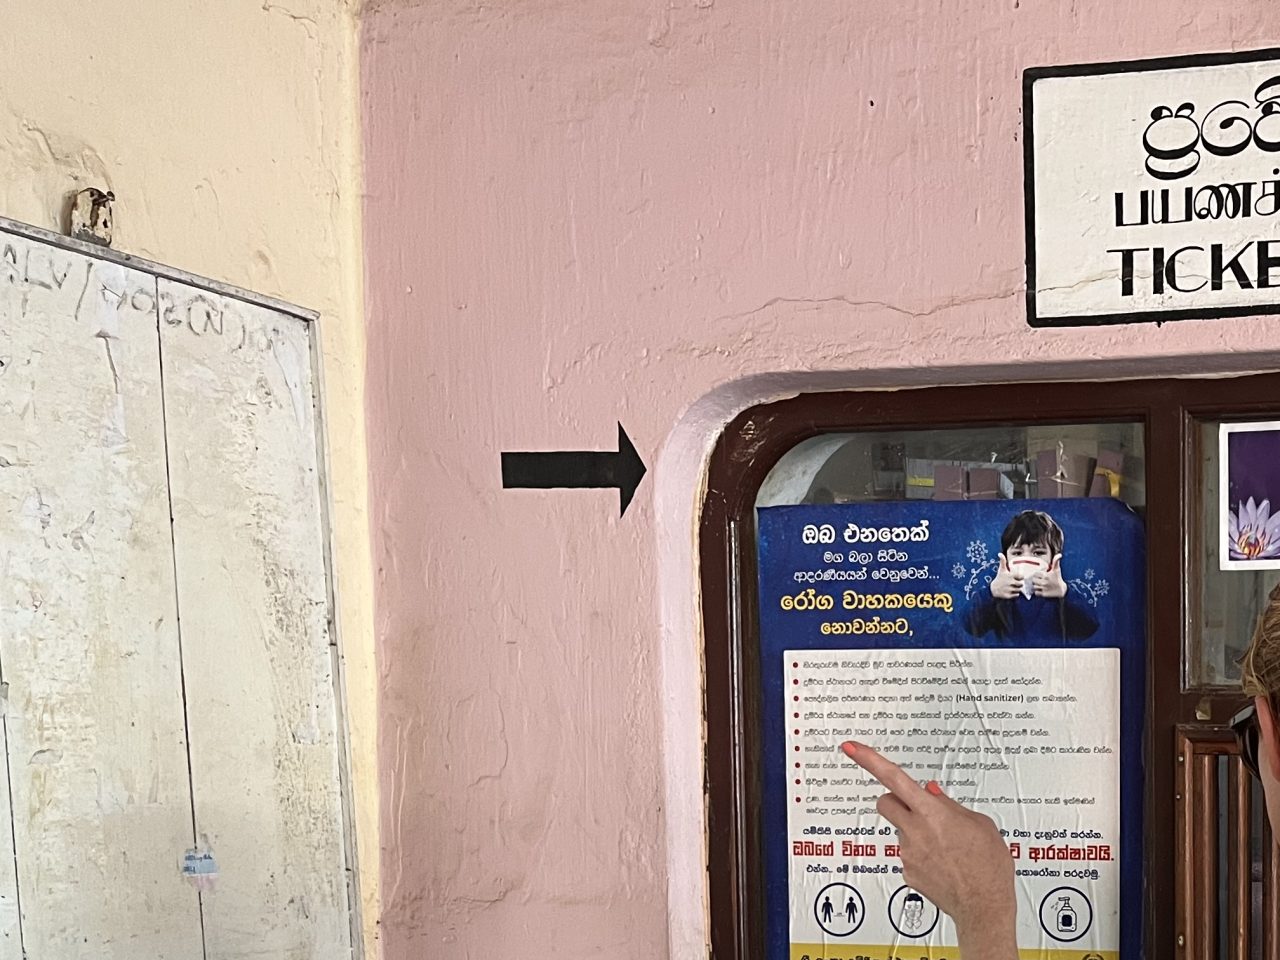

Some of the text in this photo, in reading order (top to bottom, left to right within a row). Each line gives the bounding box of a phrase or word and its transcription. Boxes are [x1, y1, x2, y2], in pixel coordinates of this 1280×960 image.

[802, 520, 930, 544] ඔබ එනතෙක්
[823, 549, 909, 564] මග බලා සිටින
[780, 589, 954, 613] රෝග වාහකයෙකු
[956, 694, 1024, 703] (Hand sanitizer)
[793, 841, 834, 856] ඔබගේ
[842, 840, 876, 856] විනය
